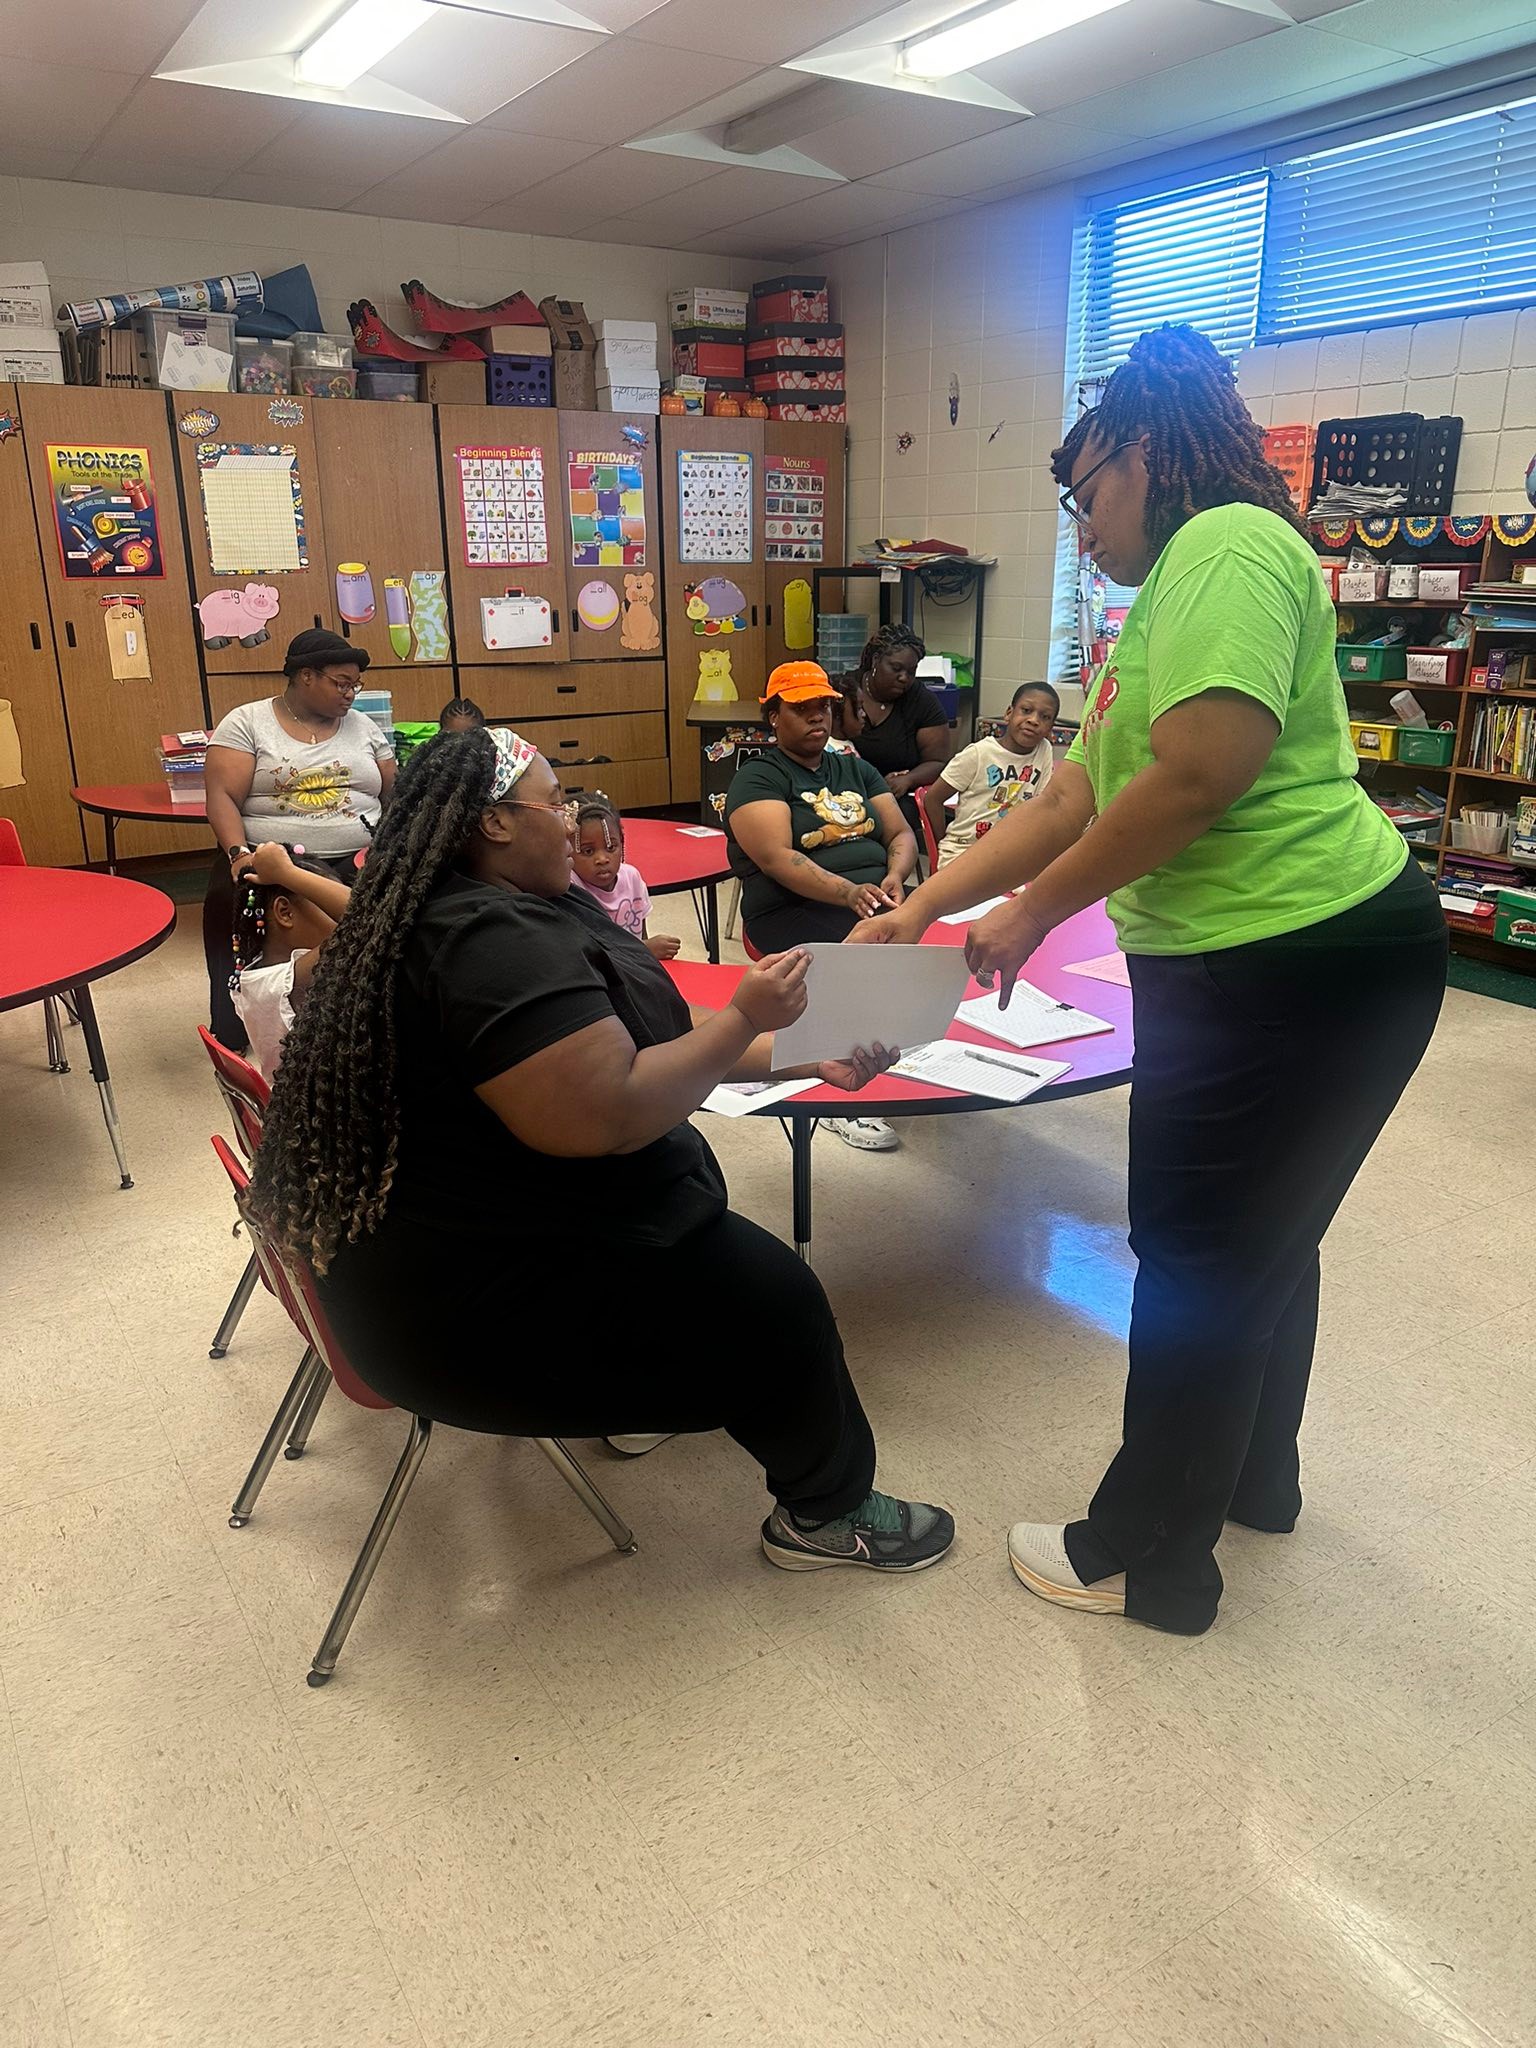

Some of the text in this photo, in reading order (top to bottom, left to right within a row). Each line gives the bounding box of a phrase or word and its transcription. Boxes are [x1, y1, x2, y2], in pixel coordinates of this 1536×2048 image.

[182, 295, 191, 303] Ss
[182, 414, 216, 432] FANTASTIC!
[460, 448, 542, 460] Beginning Blends
[576, 452, 635, 464] BIRTHDAYS
[56, 450, 142, 470] PHONICS
[783, 457, 811, 469] Nouns
[71, 470, 90, 478] Tools
[1507, 515, 1525, 527] WOW!
[1343, 578, 1368, 590] Plastic
[1421, 574, 1444, 585] Paper
[1432, 584, 1450, 594] Bags
[1354, 590, 1372, 600] Bags
[1408, 656, 1445, 670] Magnifying
[1415, 668, 1440, 679] Glasses
[986, 764, 1042, 788] BART
[1456, 888, 1480, 899] Learning
[1452, 920, 1476, 931] Learning
[1508, 934, 1521, 943] Print
